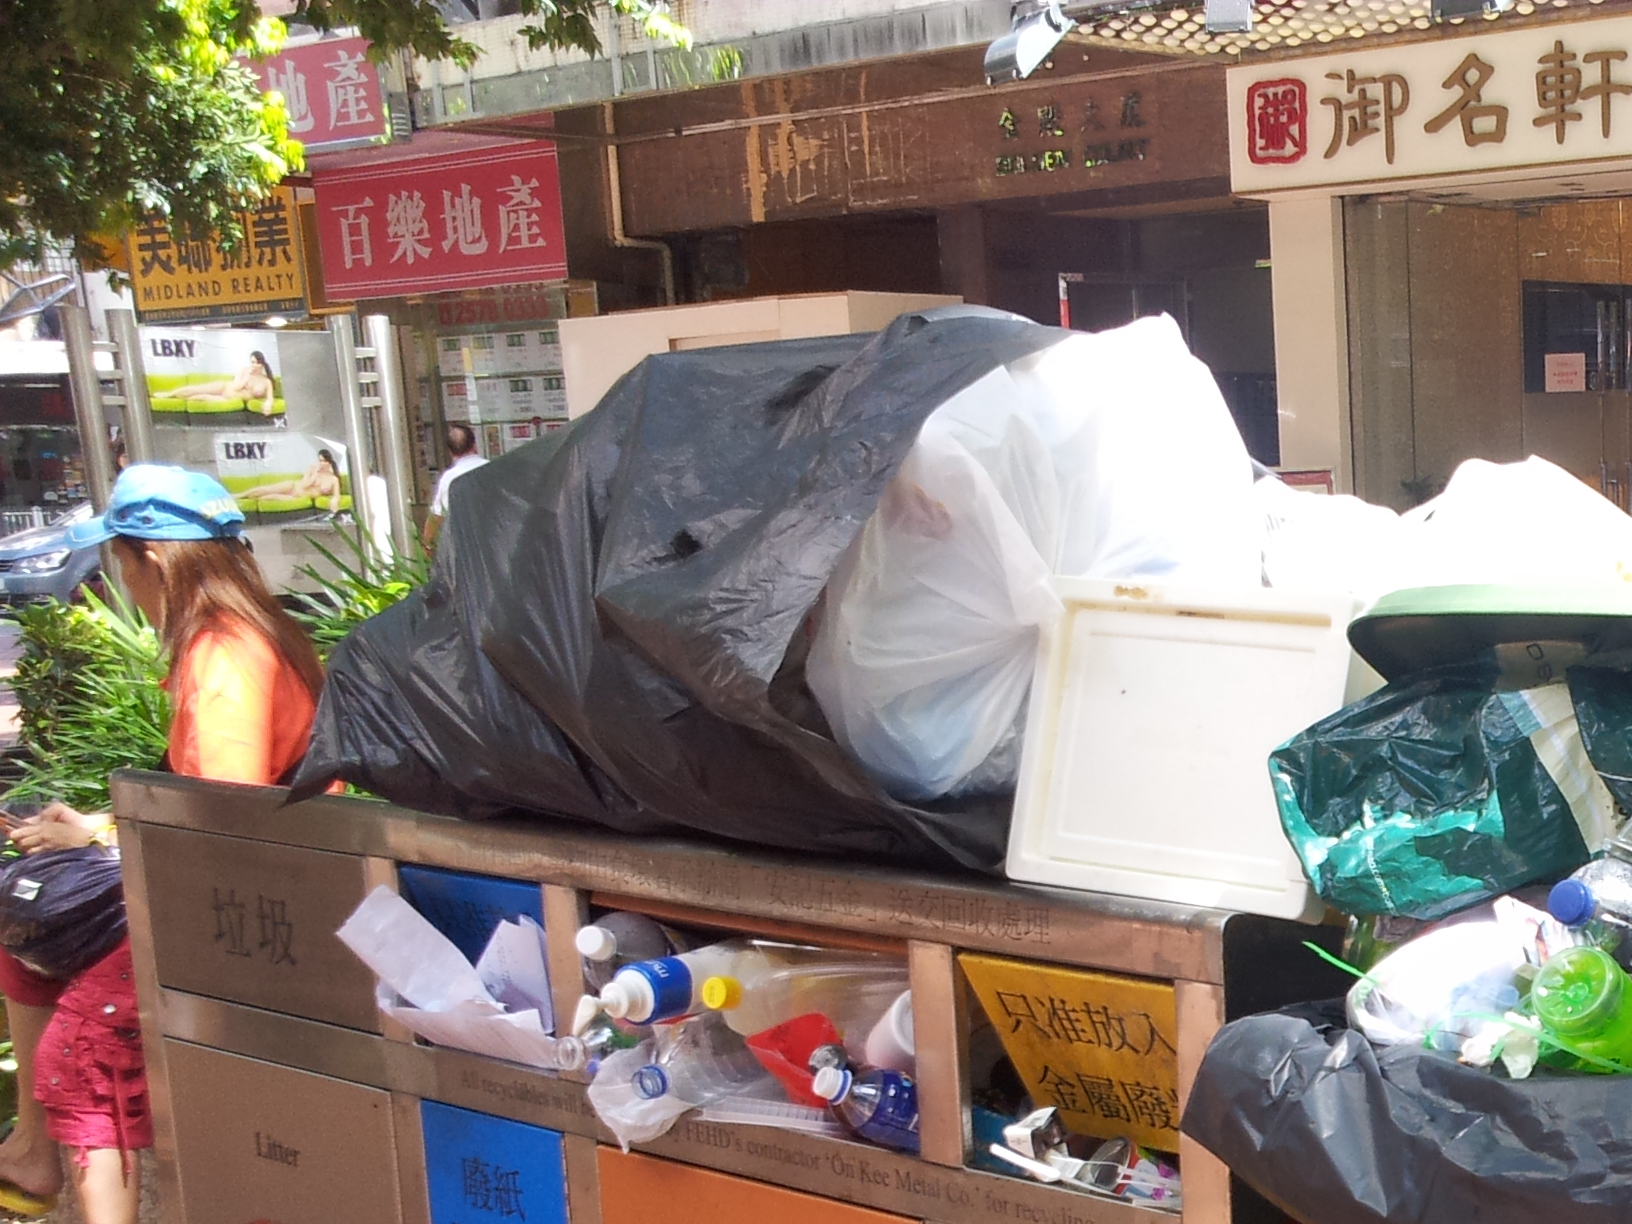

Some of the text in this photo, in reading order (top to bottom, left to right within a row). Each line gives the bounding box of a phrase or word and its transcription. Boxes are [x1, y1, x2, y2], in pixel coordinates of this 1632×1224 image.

[331, 174, 547, 269] 百樂地產
[143, 272, 295, 302] MIDLAND REALTY
[151, 338, 196, 358] LBXY
[224, 441, 267, 460] LBXY
[211, 886, 297, 967] 垃圾
[996, 990, 1177, 1056] 只准放入
[1039, 1064, 1179, 1132] 金屬廢
[254, 1131, 300, 1168] Litter
[747, 1137, 822, 1171] contractor
[894, 1168, 941, 1200] Metal
[461, 1156, 527, 1223] 廢紙
